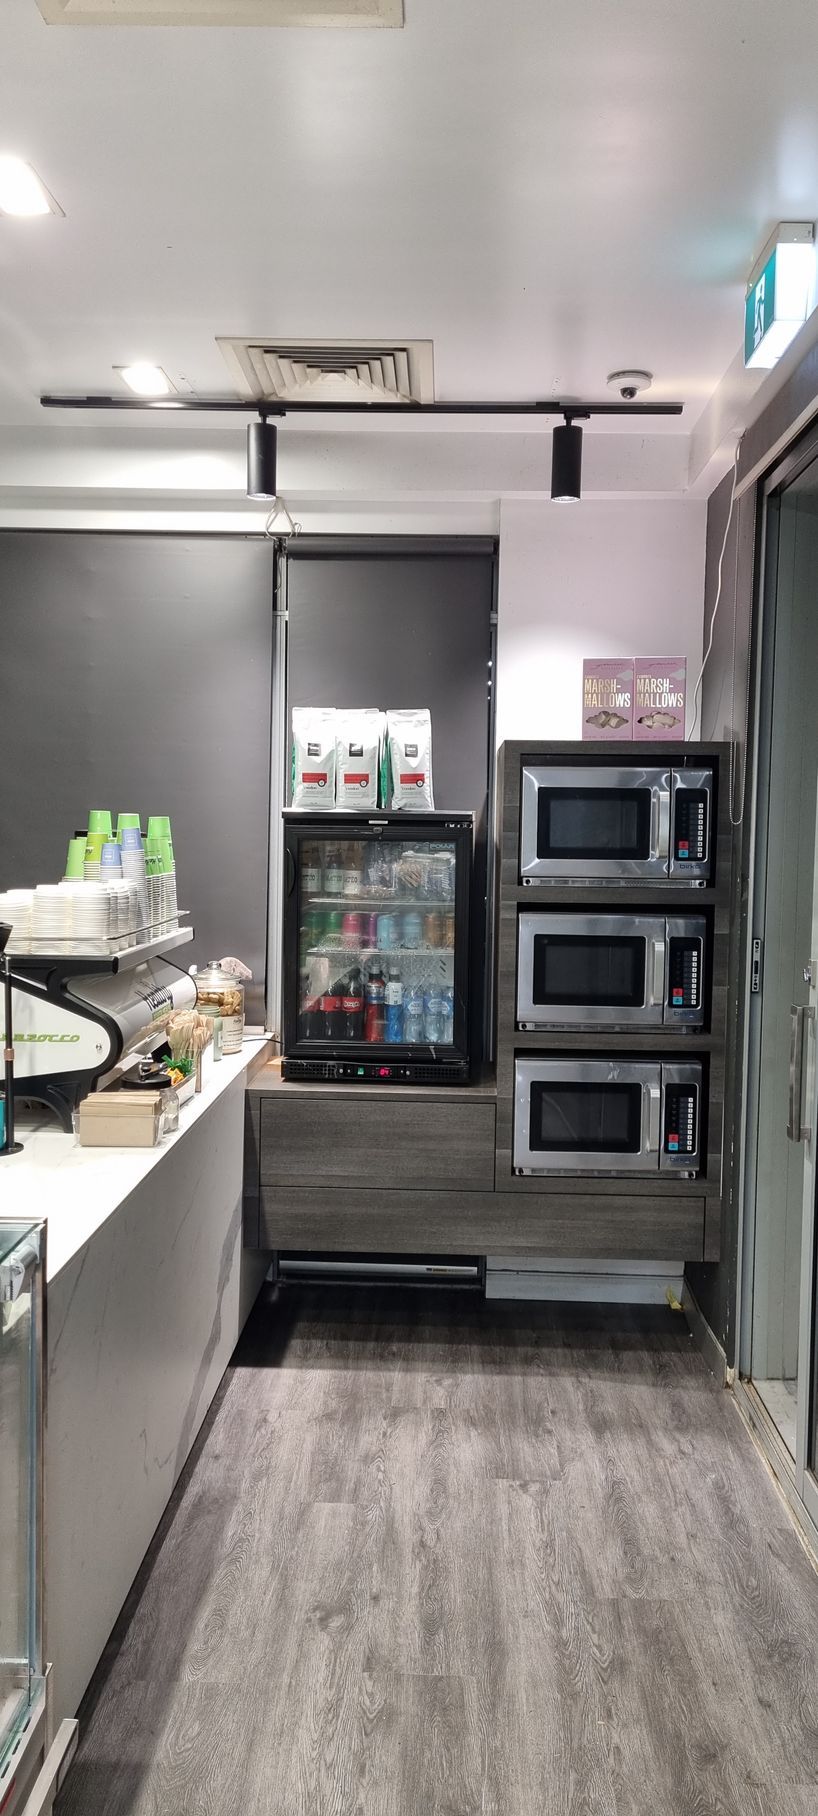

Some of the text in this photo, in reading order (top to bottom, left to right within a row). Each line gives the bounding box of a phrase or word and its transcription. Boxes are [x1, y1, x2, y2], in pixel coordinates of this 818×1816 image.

[584, 678, 622, 693] MARSH-
[636, 678, 674, 693] MARSH-
[584, 692, 631, 708] MALLOWS
[636, 692, 684, 708] MALLOWS
